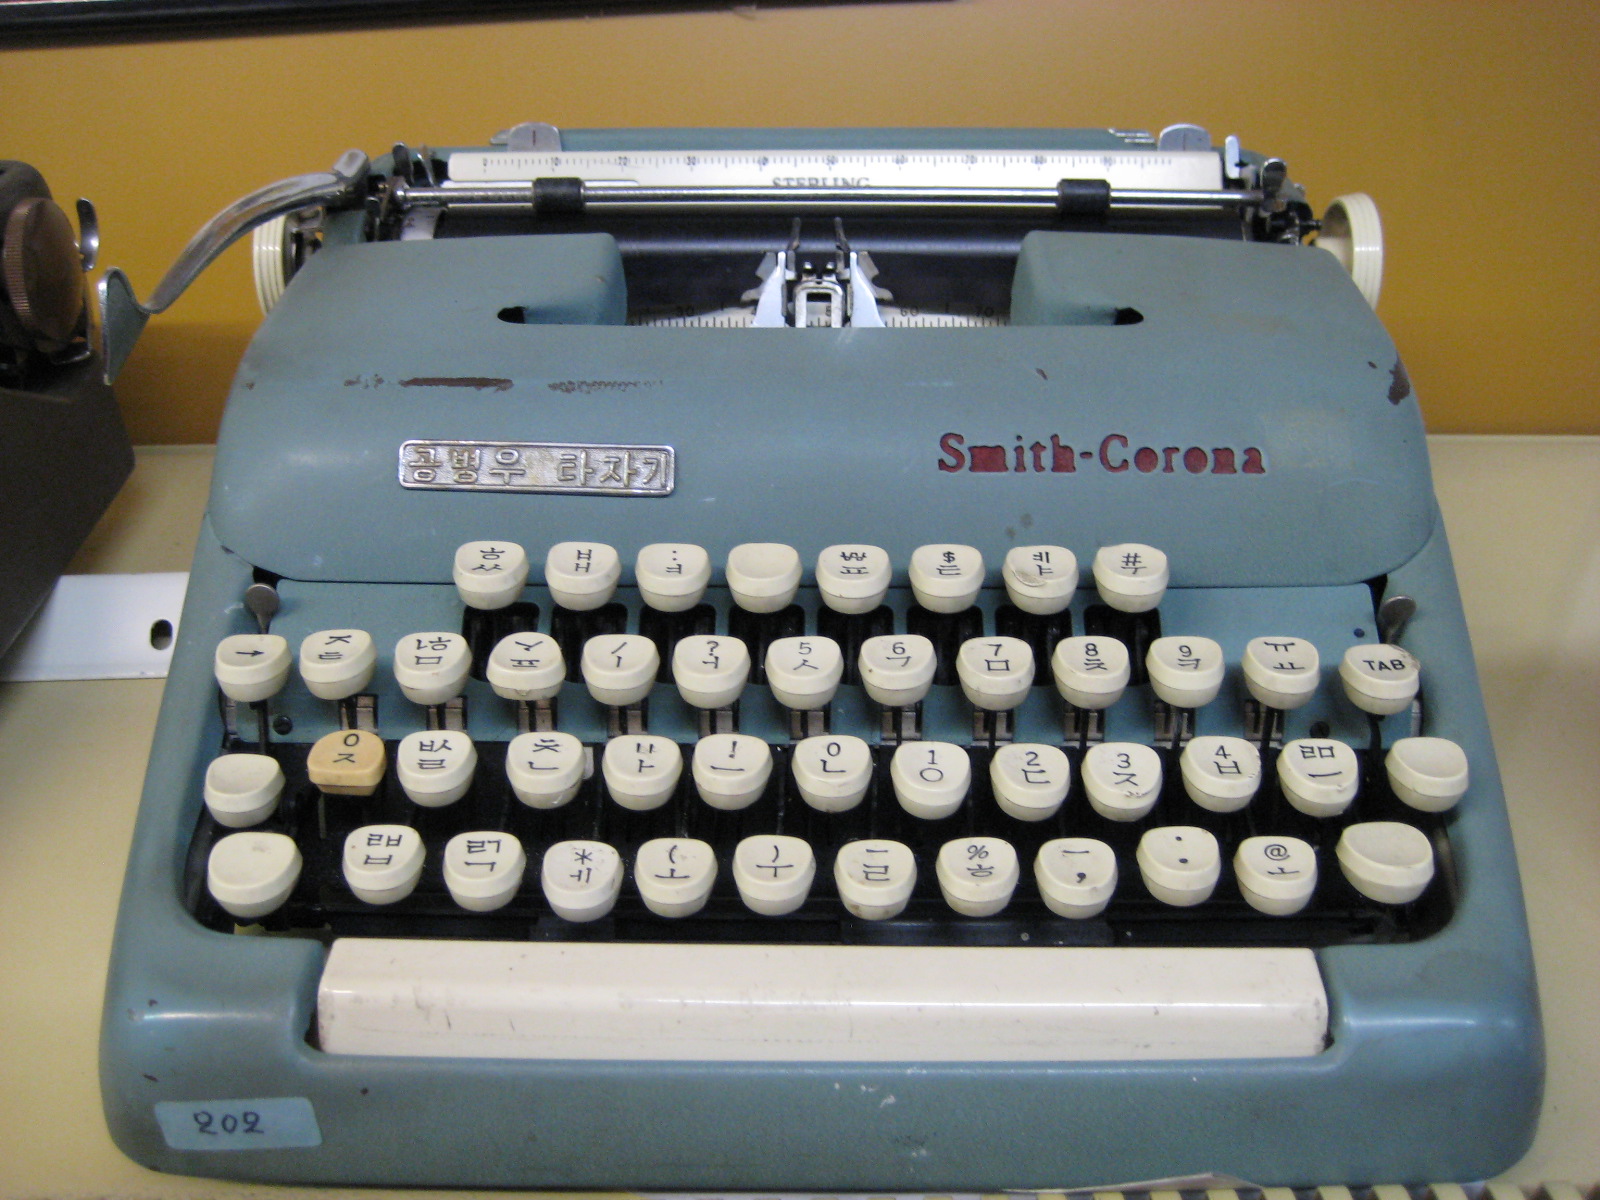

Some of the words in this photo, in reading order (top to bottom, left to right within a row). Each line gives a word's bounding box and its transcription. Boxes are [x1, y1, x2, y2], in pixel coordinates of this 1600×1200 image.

[408, 447, 527, 485] 공병우
[556, 450, 669, 490] 타자기
[937, 432, 1266, 474] Smith-Corona
[1362, 659, 1406, 672] TAB
[193, 1110, 264, 1136] 202
